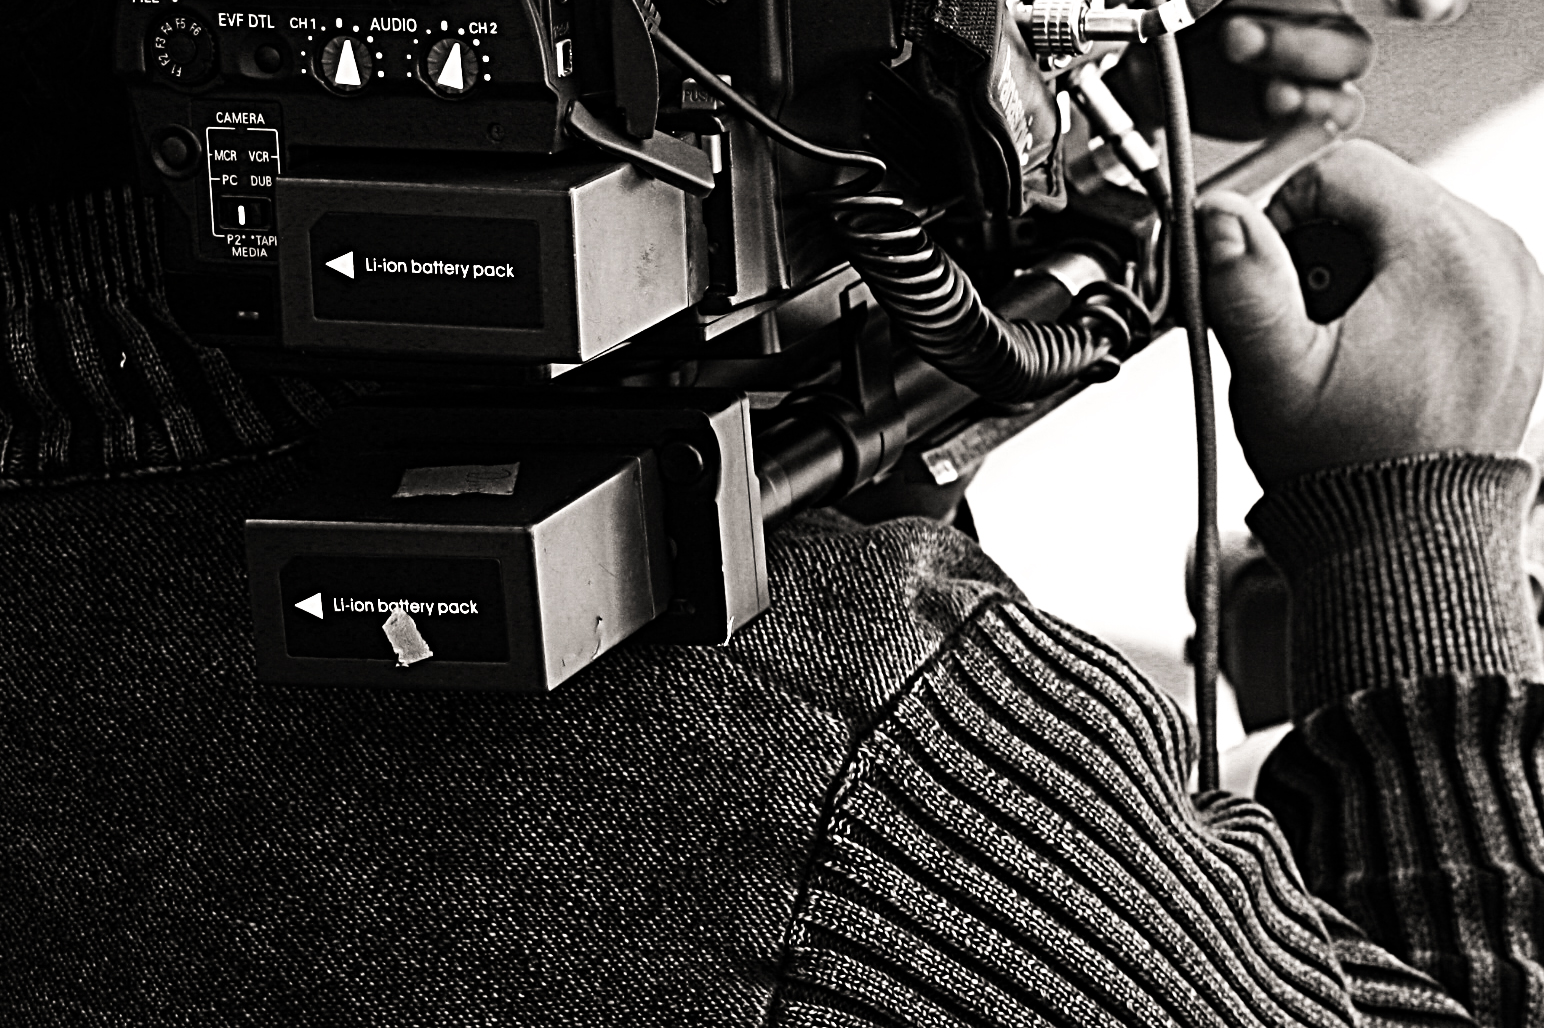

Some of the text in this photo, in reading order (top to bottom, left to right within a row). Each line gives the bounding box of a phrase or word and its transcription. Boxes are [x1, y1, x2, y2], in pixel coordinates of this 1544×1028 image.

[175, 18, 186, 29] F5
[218, 13, 275, 29] EVF DTL
[370, 17, 417, 32] AUDIO
[161, 22, 173, 35] F4
[189, 22, 202, 36] F6
[155, 37, 166, 49] F3
[158, 53, 171, 66] F2
[171, 64, 182, 77] F1
[216, 112, 265, 124] CAMERA
[214, 149, 270, 162] MCR VCR
[222, 174, 272, 186] PC DUB
[227, 234, 241, 245] P2
[232, 247, 268, 257] MEDIA
[365, 258, 515, 279] Li-ion battery pack
[333, 598, 479, 616] Li-ion battery pack
